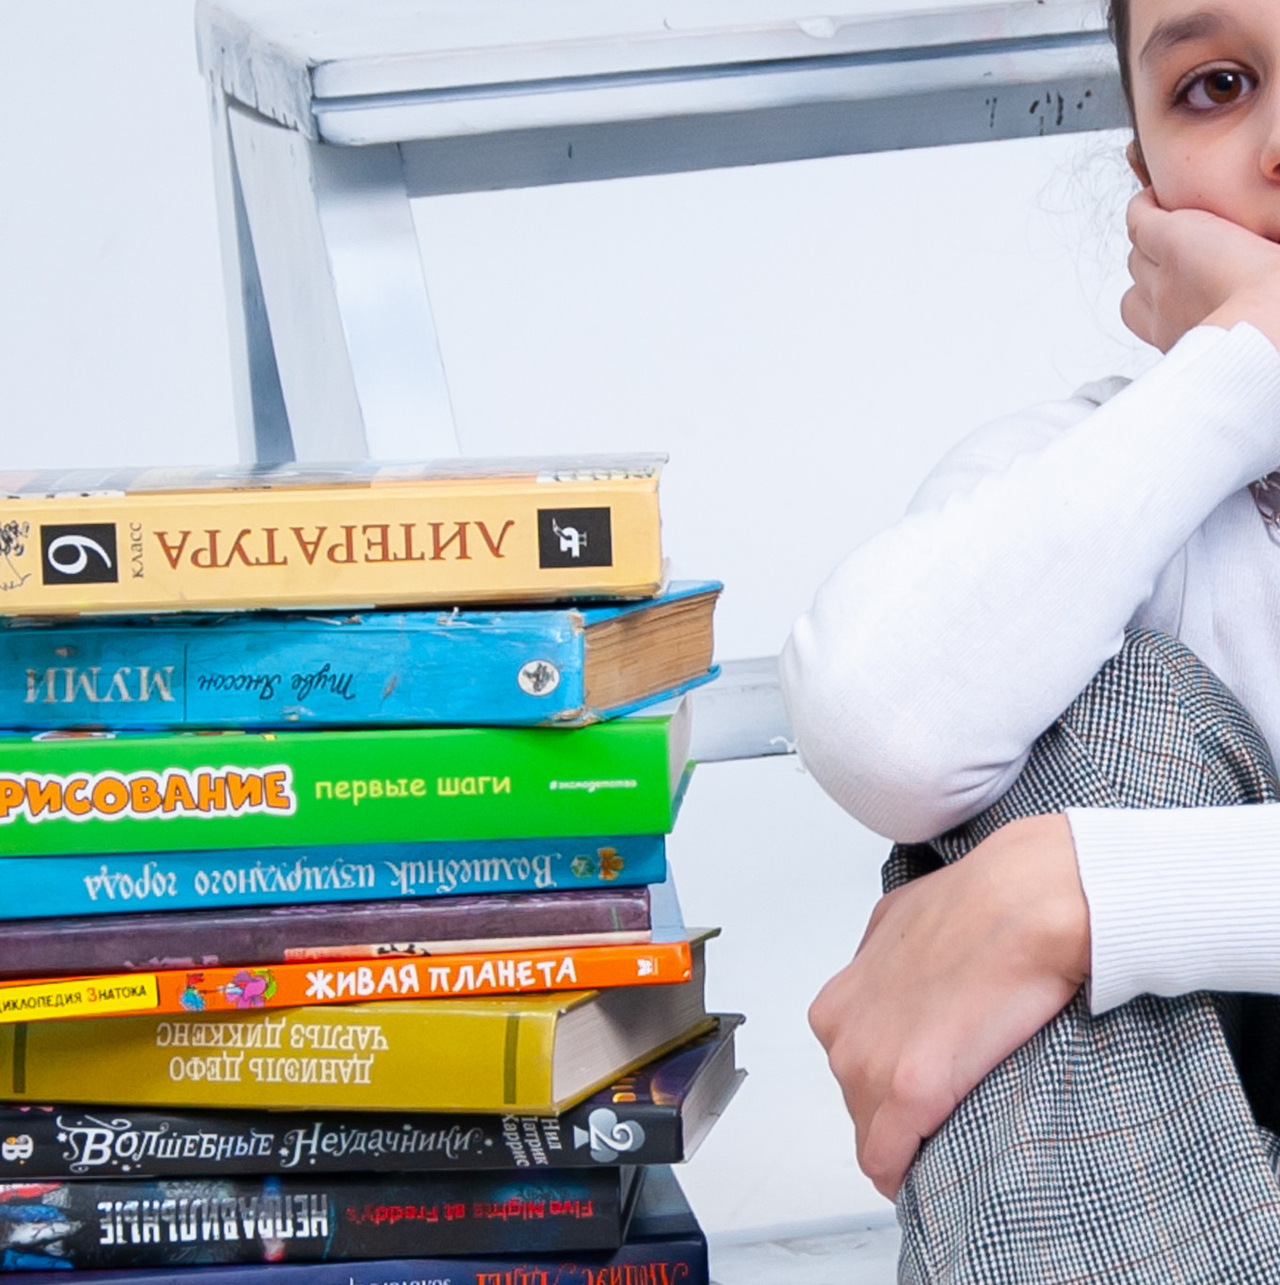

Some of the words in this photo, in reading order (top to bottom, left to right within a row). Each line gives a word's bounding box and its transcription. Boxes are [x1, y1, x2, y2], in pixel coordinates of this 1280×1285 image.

[132, 522, 145, 579] класс
[153, 520, 515, 570] ЛИТЕРАТУРА
[198, 675, 281, 701] Янссон
[0, 772, 290, 816] РИСОВАНИЕ
[315, 778, 426, 805] первые
[437, 776, 511, 796] шаги
[84, 862, 177, 900] города
[194, 857, 375, 897] изумрудного
[385, 847, 561, 894] Волшебник
[305, 965, 419, 999] ЖИВАЯ
[428, 958, 577, 992] ПЛАНЕТА
[0, 992, 82, 1013] ИКЛОПЕДИЯ
[156, 1018, 285, 1048] ДИККЕНС
[290, 1022, 389, 1051] ЧАРЛЬЗ
[169, 1051, 244, 1082] ДЕФО
[249, 1054, 374, 1084] ДАНИЭЛЬ
[541, 1116, 562, 1150] Нил
[444, 1202, 466, 1220] at
[473, 1198, 545, 1220] Nights
[550, 1200, 593, 1218] Five
